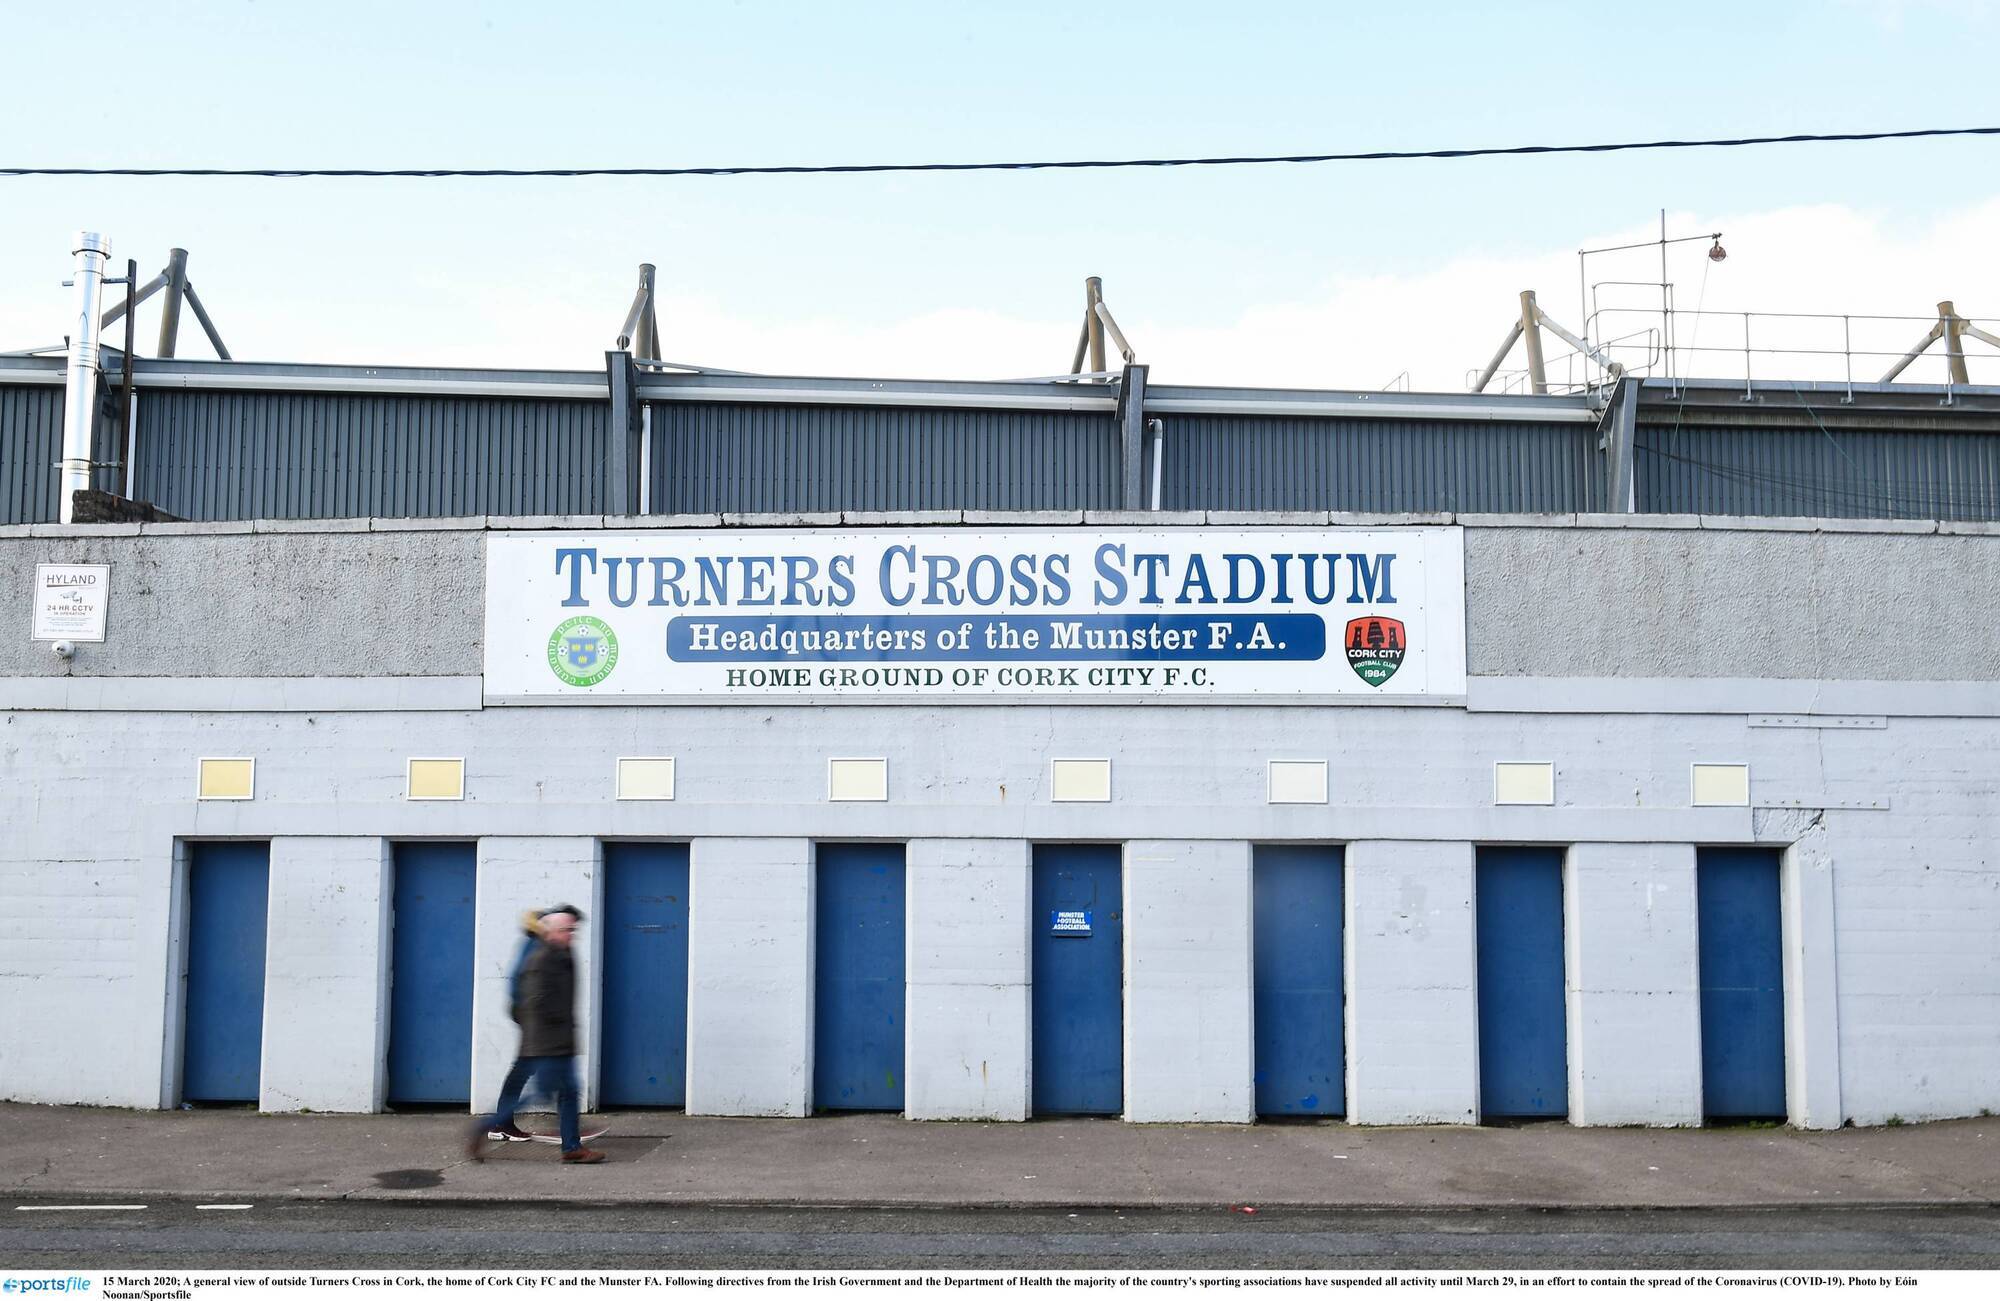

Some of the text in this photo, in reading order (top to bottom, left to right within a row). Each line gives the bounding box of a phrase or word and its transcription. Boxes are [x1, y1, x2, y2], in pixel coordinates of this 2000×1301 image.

[46, 574, 97, 585] HYLAND
[555, 543, 1397, 607] TURNERS CROSS STADIUM
[47, 604, 94, 612] 24 HR CCTV
[688, 621, 1287, 655] Headquarters of the Munster F.A.
[1348, 649, 1402, 658] CORK CITY
[1354, 660, 1398, 670] FOOTBALL CLUB
[726, 667, 1215, 687] HOME GROUND OF CORK CITY F.C.
[1364, 669, 1386, 678] 1984
